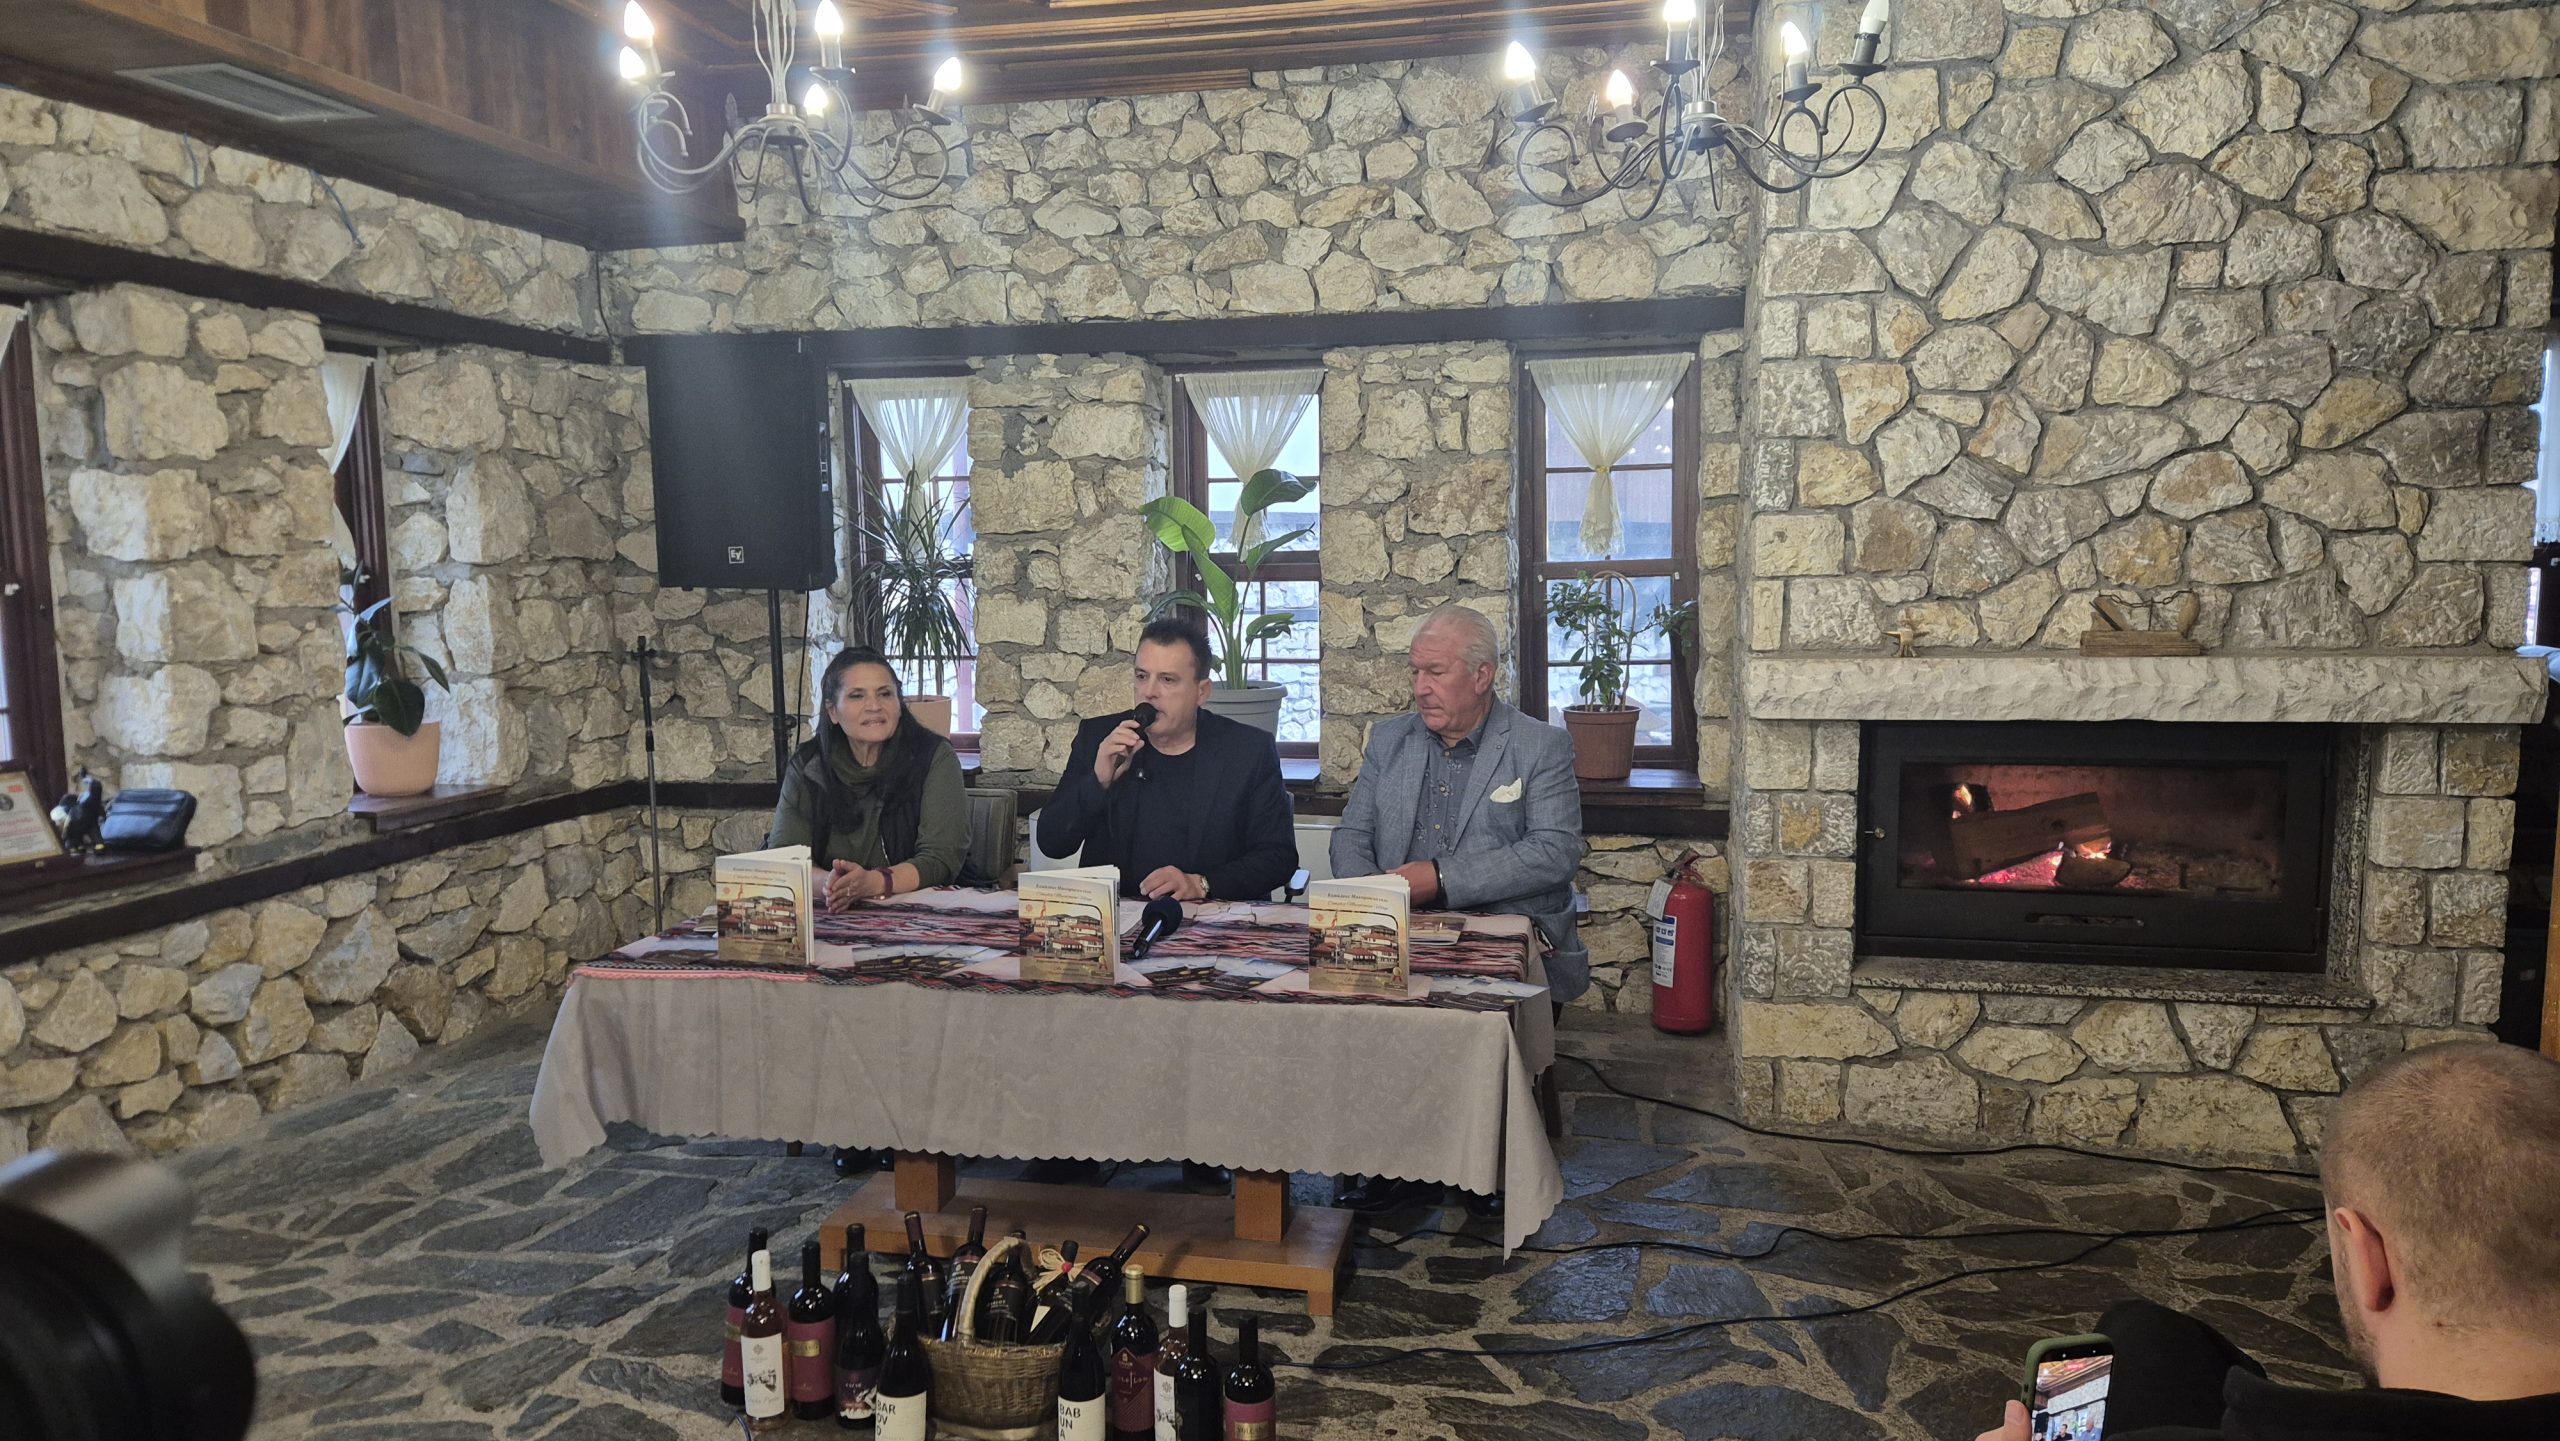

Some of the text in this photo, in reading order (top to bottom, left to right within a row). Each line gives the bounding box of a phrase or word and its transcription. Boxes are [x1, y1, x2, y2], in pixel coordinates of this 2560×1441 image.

[1059, 1403, 1081, 1418] BAB
[1059, 1416, 1073, 1430] UN
[1059, 1428, 1066, 1441] A
